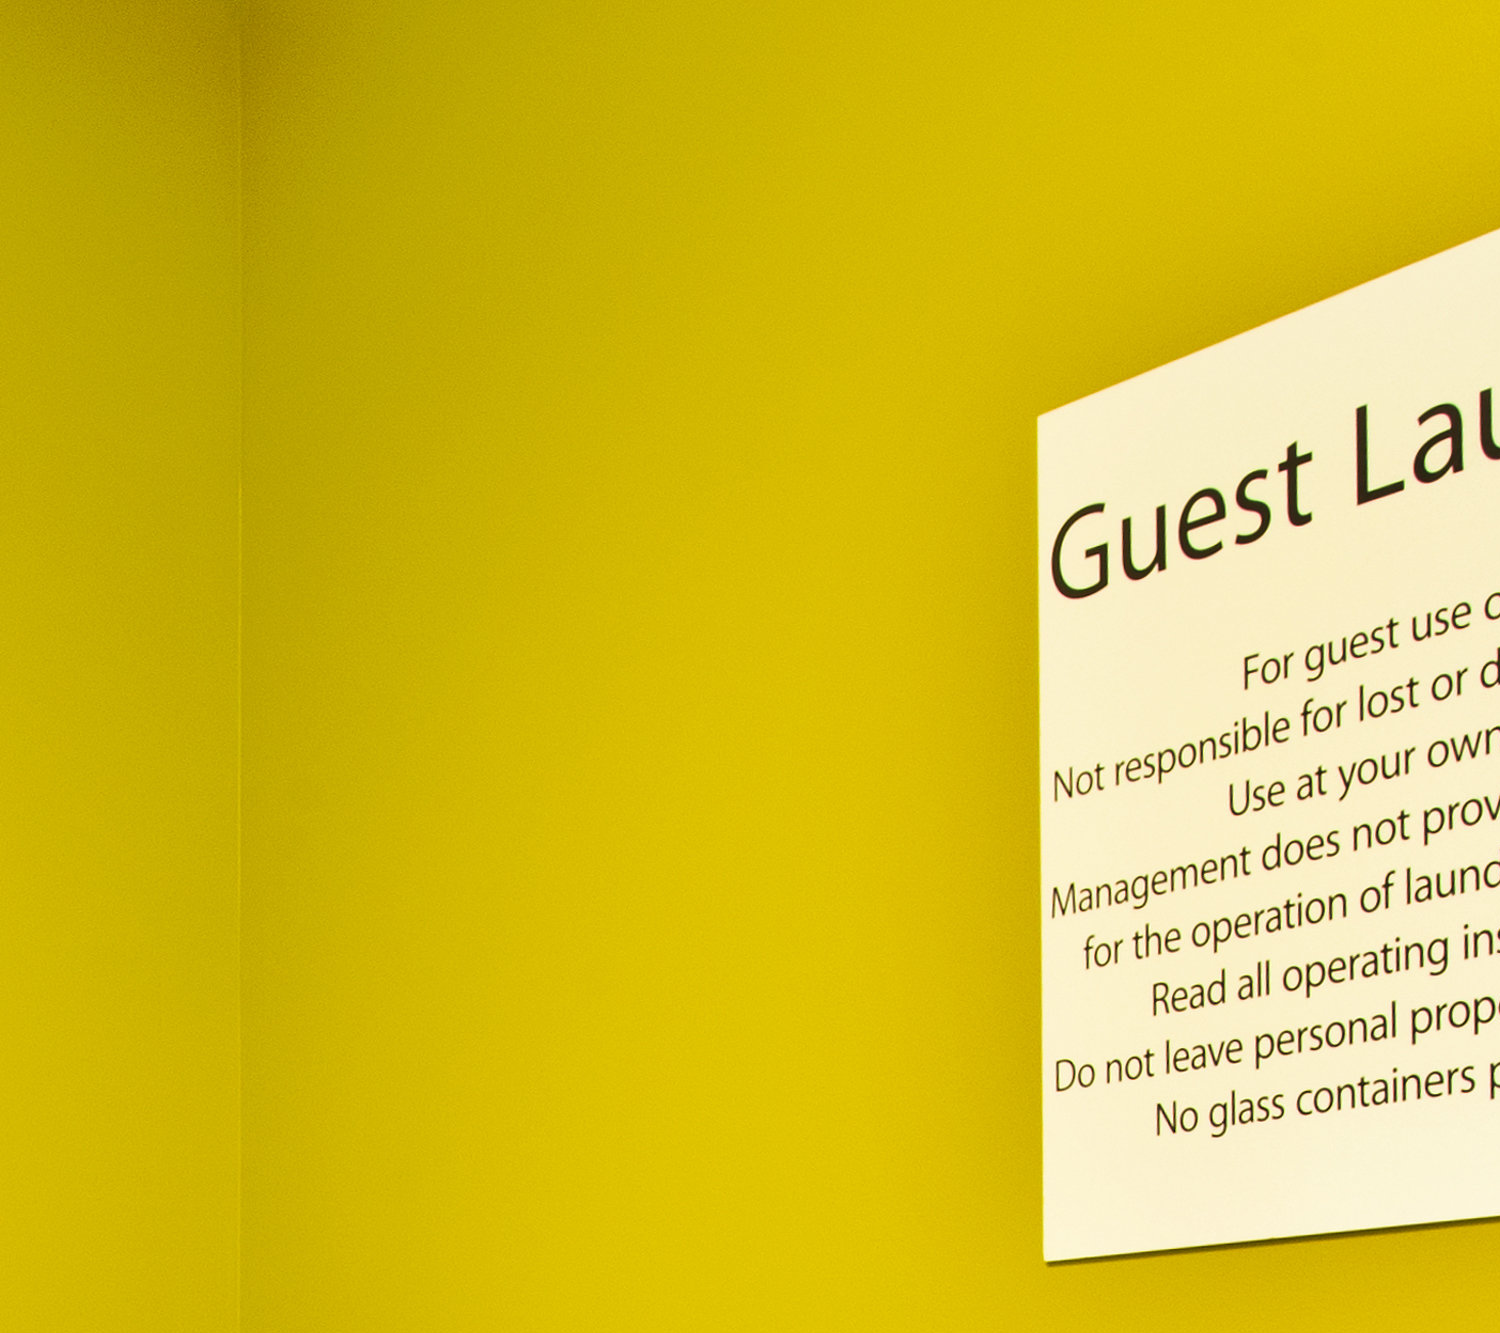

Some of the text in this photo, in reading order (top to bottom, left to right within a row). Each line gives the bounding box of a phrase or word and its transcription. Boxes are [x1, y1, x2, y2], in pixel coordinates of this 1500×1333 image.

[1051, 441, 1313, 600] Guest
[1243, 652, 1295, 691] For
[1304, 617, 1399, 683] guest
[1411, 601, 1472, 642] use
[1054, 763, 1105, 802] Not
[1115, 710, 1291, 786] responsible
[1300, 697, 1348, 737] for
[1359, 677, 1420, 722] lost
[1431, 667, 1469, 702] or
[1229, 779, 1286, 817] Use
[1296, 765, 1328, 801] at
[1337, 746, 1416, 802] your
[1051, 846, 1252, 919] Management
[1261, 830, 1340, 871] does
[1353, 809, 1411, 852] not
[1083, 934, 1124, 970] for
[1132, 923, 1182, 960] the
[1191, 892, 1347, 954] operation
[1359, 869, 1396, 914] of
[1152, 968, 1226, 1017] Read
[1237, 959, 1270, 1001] all
[1282, 936, 1449, 999] operating
[1055, 1058, 1096, 1092] Do
[1106, 1049, 1155, 1084] not
[1165, 1038, 1243, 1075] leave
[1255, 1000, 1397, 1070] personal
[1156, 1100, 1199, 1137] No
[1209, 1089, 1285, 1139] glass
[1296, 1065, 1476, 1116] containers
